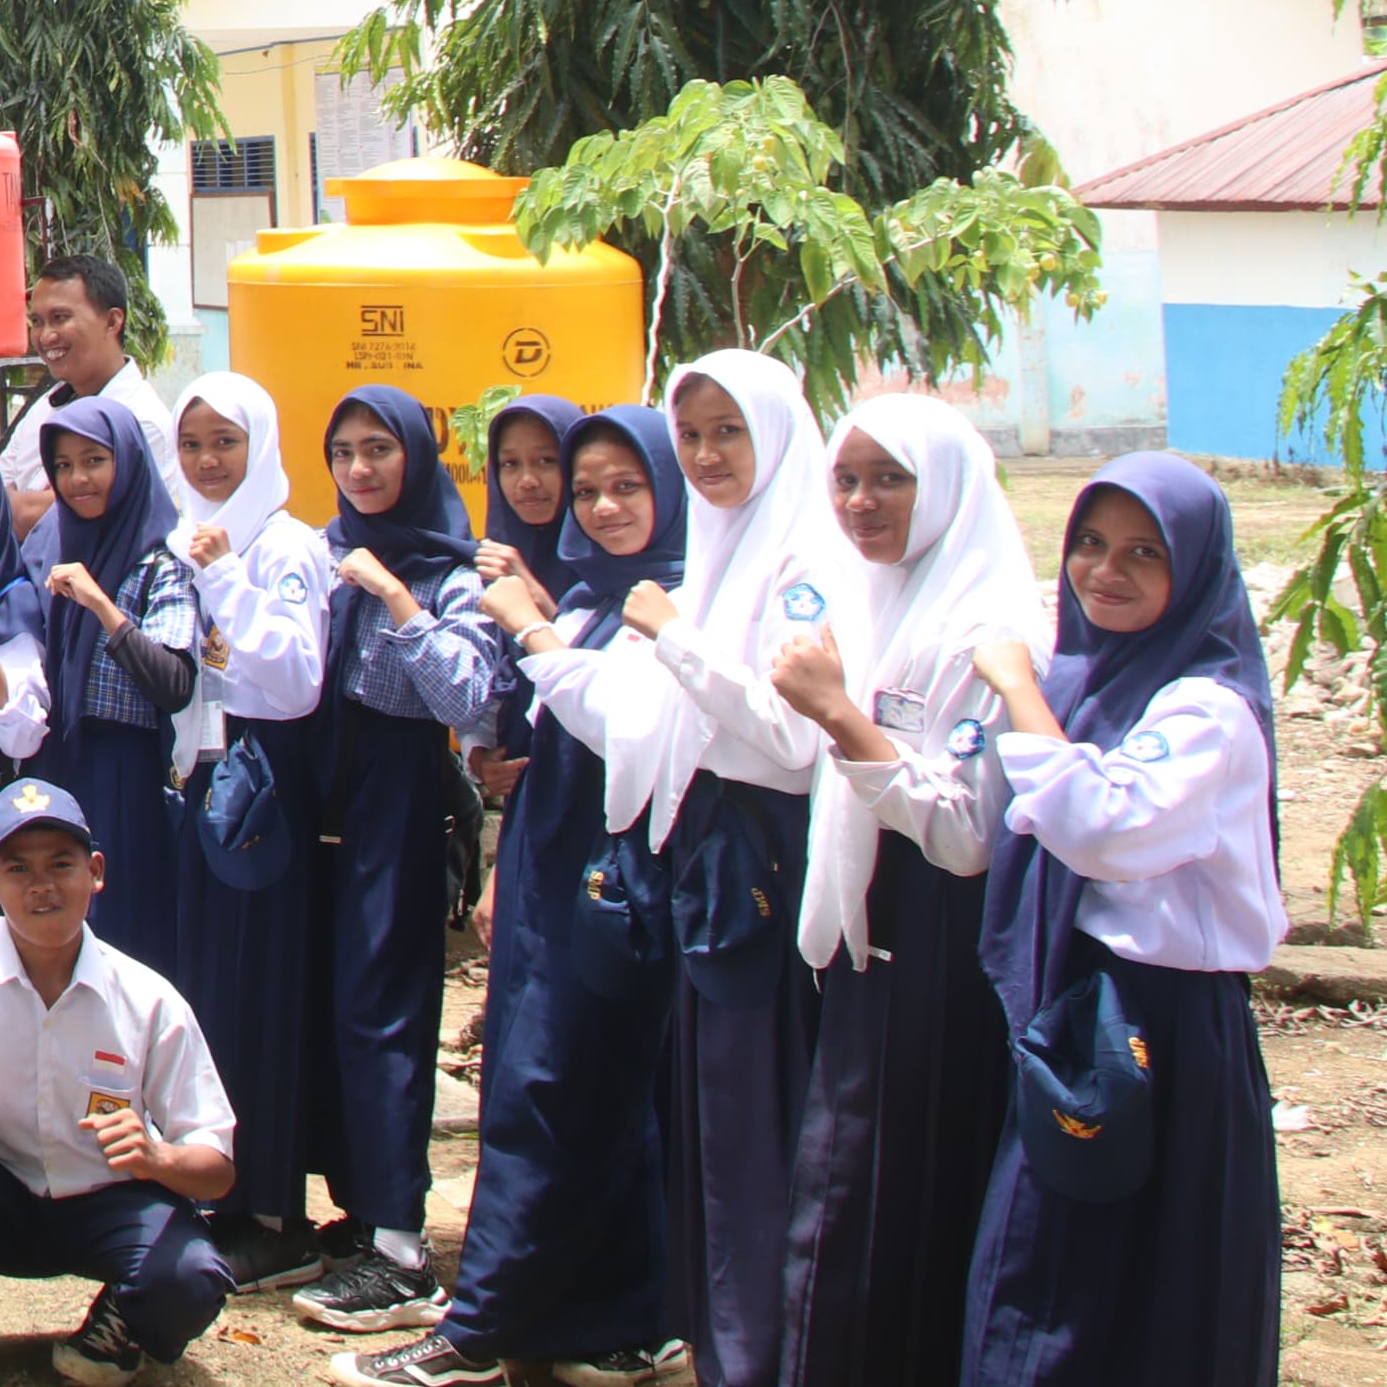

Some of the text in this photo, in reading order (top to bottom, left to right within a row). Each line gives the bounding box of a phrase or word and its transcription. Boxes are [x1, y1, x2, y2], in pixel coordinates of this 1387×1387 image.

[360, 309, 405, 333] SNI
[587, 869, 604, 901] SMP
[751, 887, 772, 918] SMP
